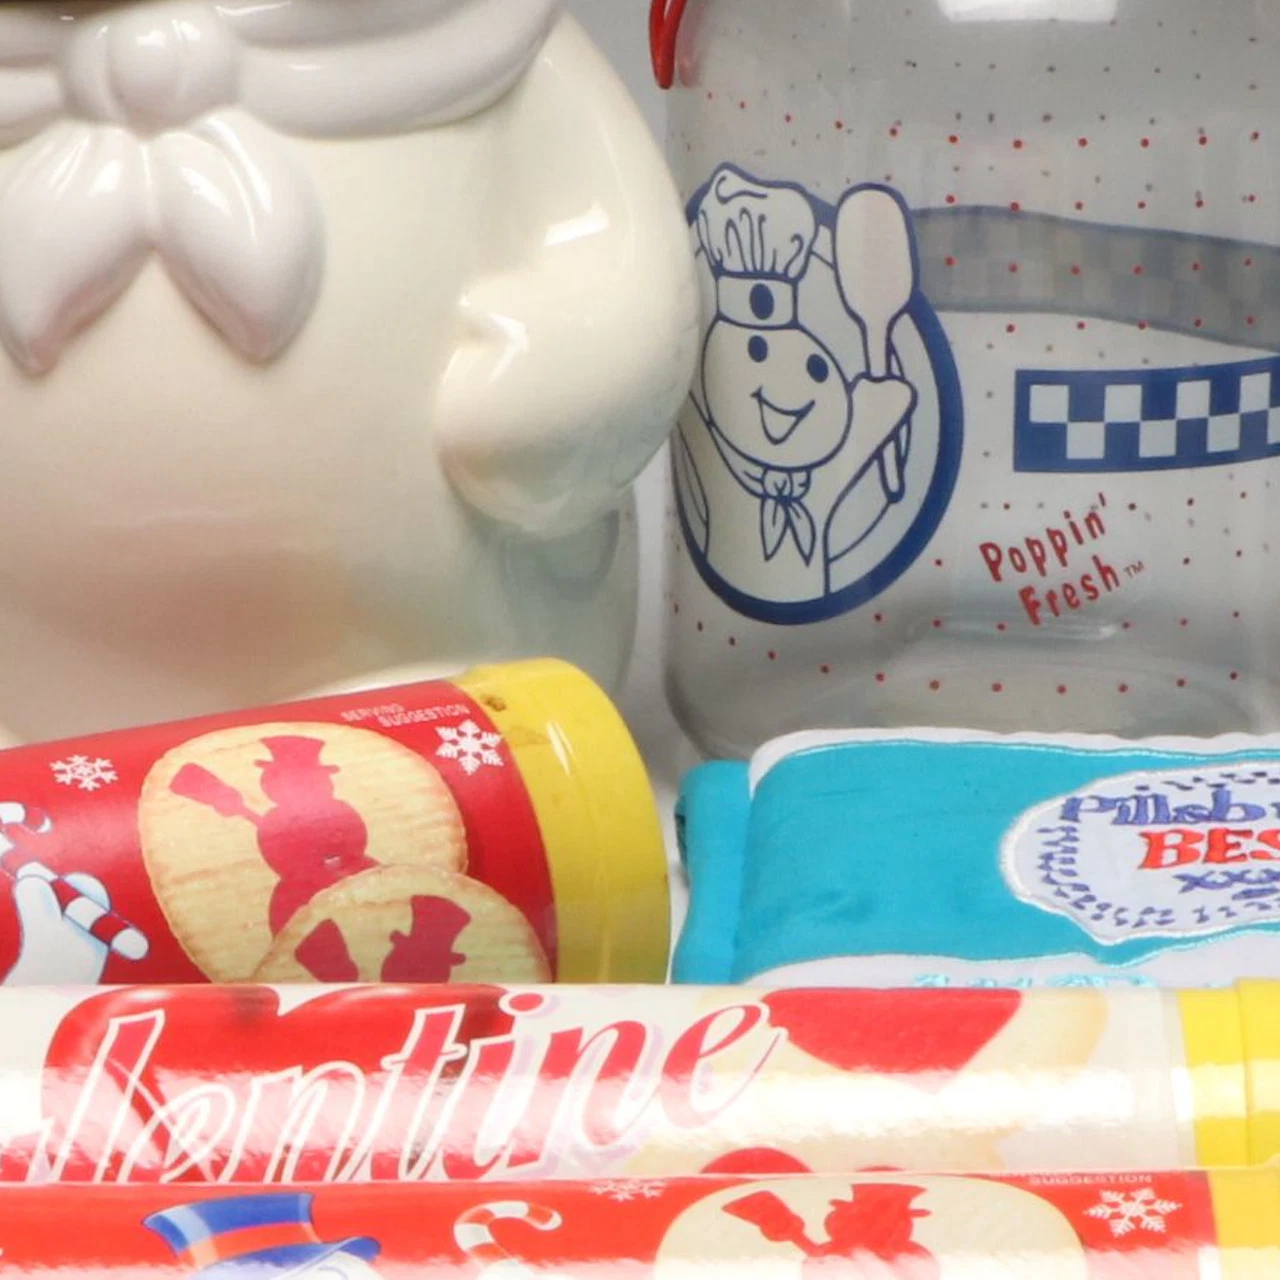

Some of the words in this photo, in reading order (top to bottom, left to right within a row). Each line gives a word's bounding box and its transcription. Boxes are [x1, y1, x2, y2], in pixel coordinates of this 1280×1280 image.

[978, 491, 1107, 583] Poppin'
[1018, 554, 1121, 627] Fresh
[377, 703, 470, 728] SUGGESTION
